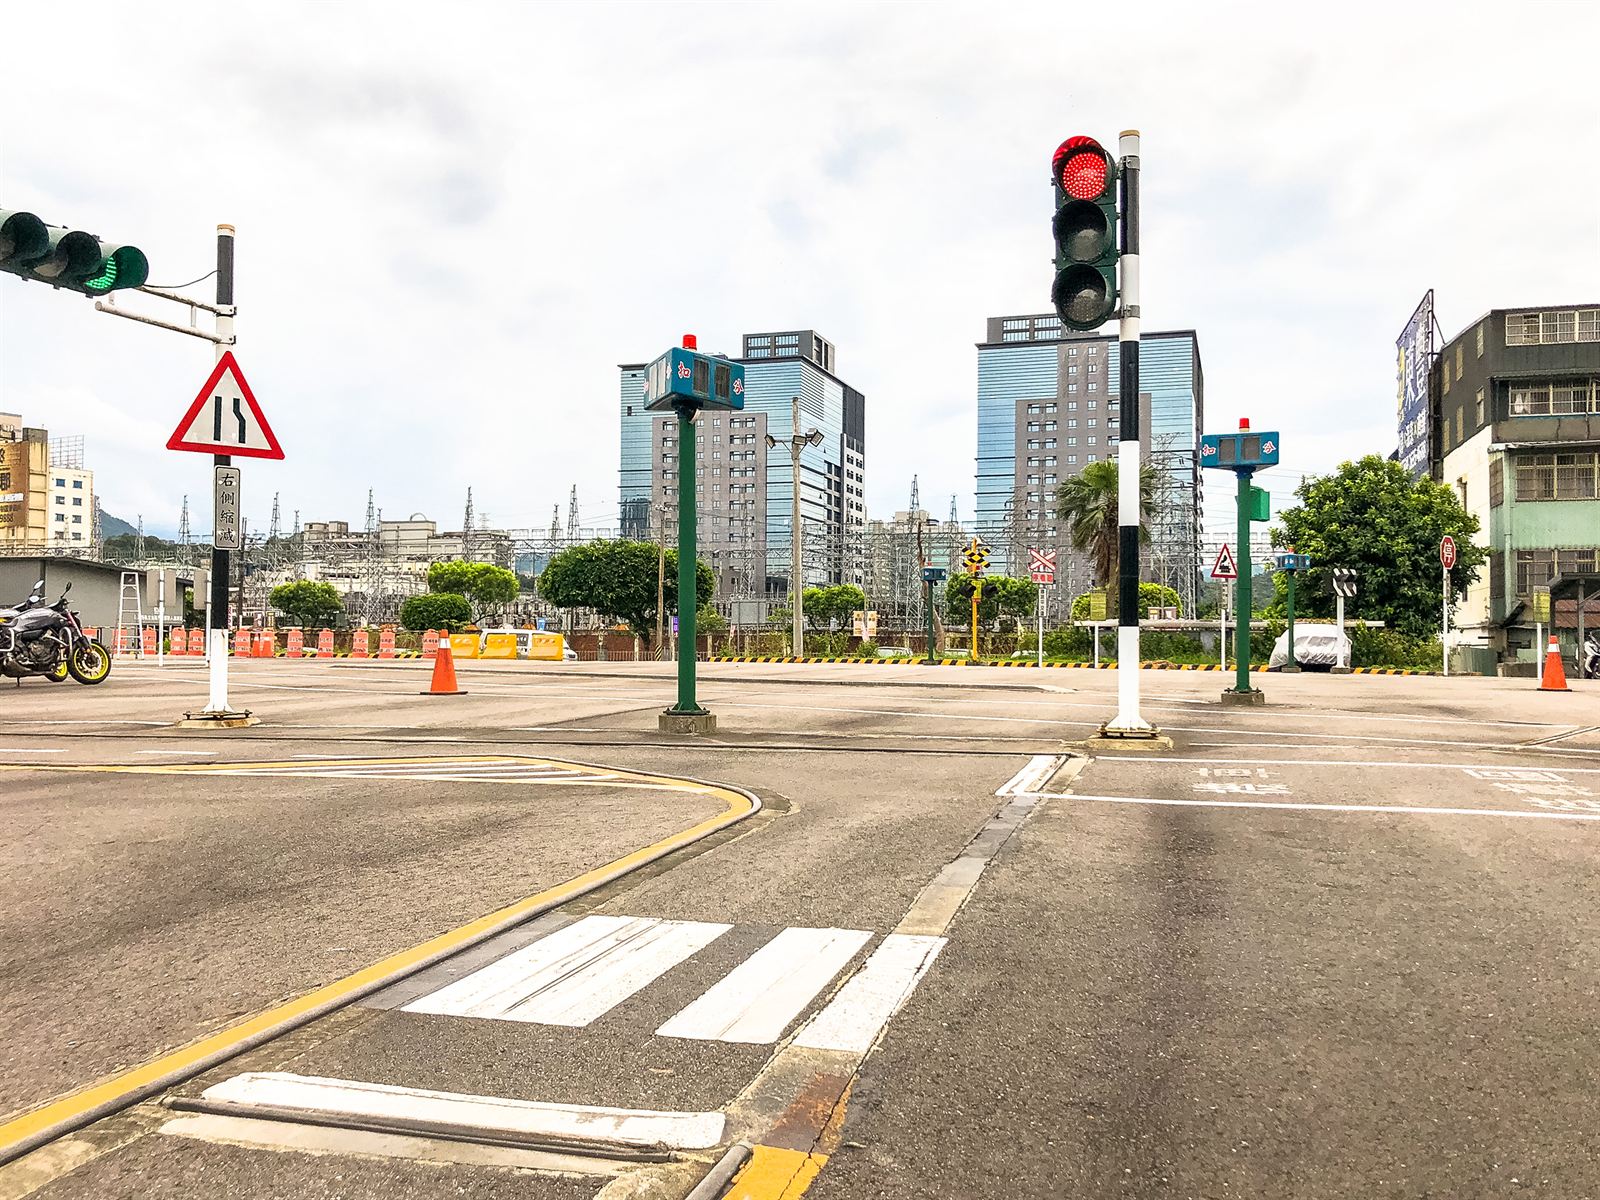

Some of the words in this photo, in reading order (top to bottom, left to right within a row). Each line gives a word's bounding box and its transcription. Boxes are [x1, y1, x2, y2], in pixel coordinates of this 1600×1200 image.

[219, 473, 235, 543] 右側縮減
[1443, 542, 1453, 563] 停
